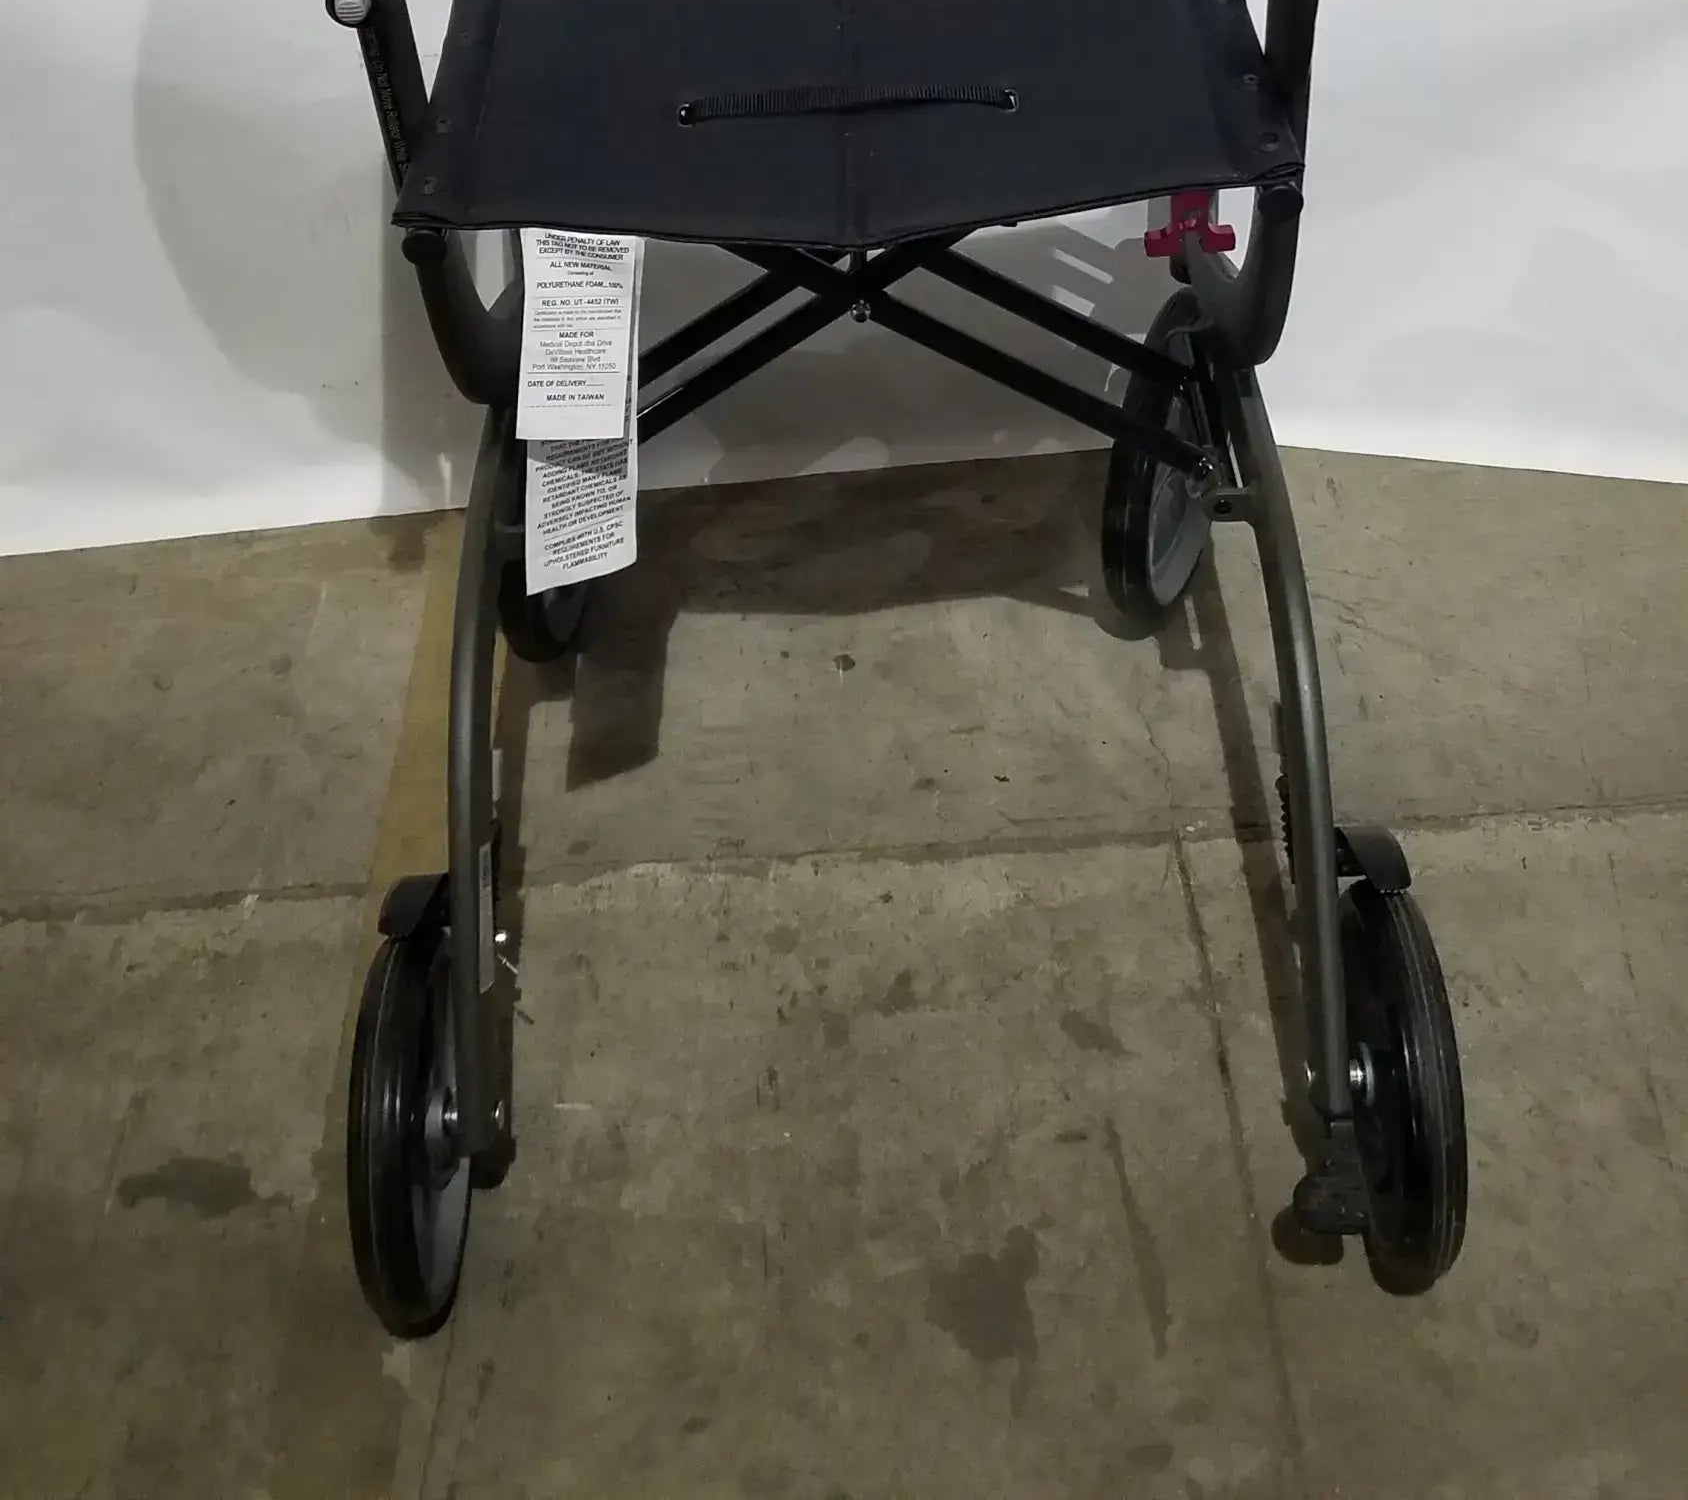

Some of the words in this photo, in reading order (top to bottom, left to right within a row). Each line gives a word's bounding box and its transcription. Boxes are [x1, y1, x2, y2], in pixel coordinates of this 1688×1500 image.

[536, 239, 550, 247] THIS
[588, 245, 597, 253] BE
[598, 246, 630, 254] REMOVED
[544, 232, 566, 242] UNDER
[567, 235, 595, 245] PENALTY
[596, 238, 604, 246] OF
[539, 247, 563, 255] EXCEPT
[575, 249, 586, 257] THE
[587, 251, 624, 261] CONSUMER
[549, 261, 563, 269] ALL
[580, 261, 612, 271] MATERIAL
[536, 281, 584, 289] POLYURETHANE
[603, 297, 619, 305] (TW)
[598, 362, 616, 370] 11050
[577, 393, 604, 401] TAIWAN
[582, 474, 600, 483] MANY
[542, 486, 580, 503] RETARDANT
[580, 477, 617, 491] CHEMICALS
[551, 499, 570, 509] BEING
[571, 491, 595, 502] KNOWN
[607, 484, 617, 492] OR
[537, 513, 573, 530] ADVERSELY
[574, 502, 607, 518] IMPACTING
[608, 495, 631, 507] HUMAN
[543, 504, 576, 519] STRONGLY
[577, 493, 614, 508] SUSPECTED
[615, 489, 624, 497] OF
[543, 523, 567, 535] HEALTH
[567, 519, 577, 527] OR
[578, 505, 624, 524] DEVELOPMENT
[544, 537, 575, 551] COMPLIES
[576, 530, 593, 540] WITH
[606, 520, 624, 531] CPSC
[552, 534, 601, 555] REQUIREMENTS
[602, 531, 615, 541] FOR
[543, 548, 589, 567] UPHOLSTERED
[590, 537, 625, 553] FURNITURE
[562, 551, 609, 570] FLAMMABILITY
